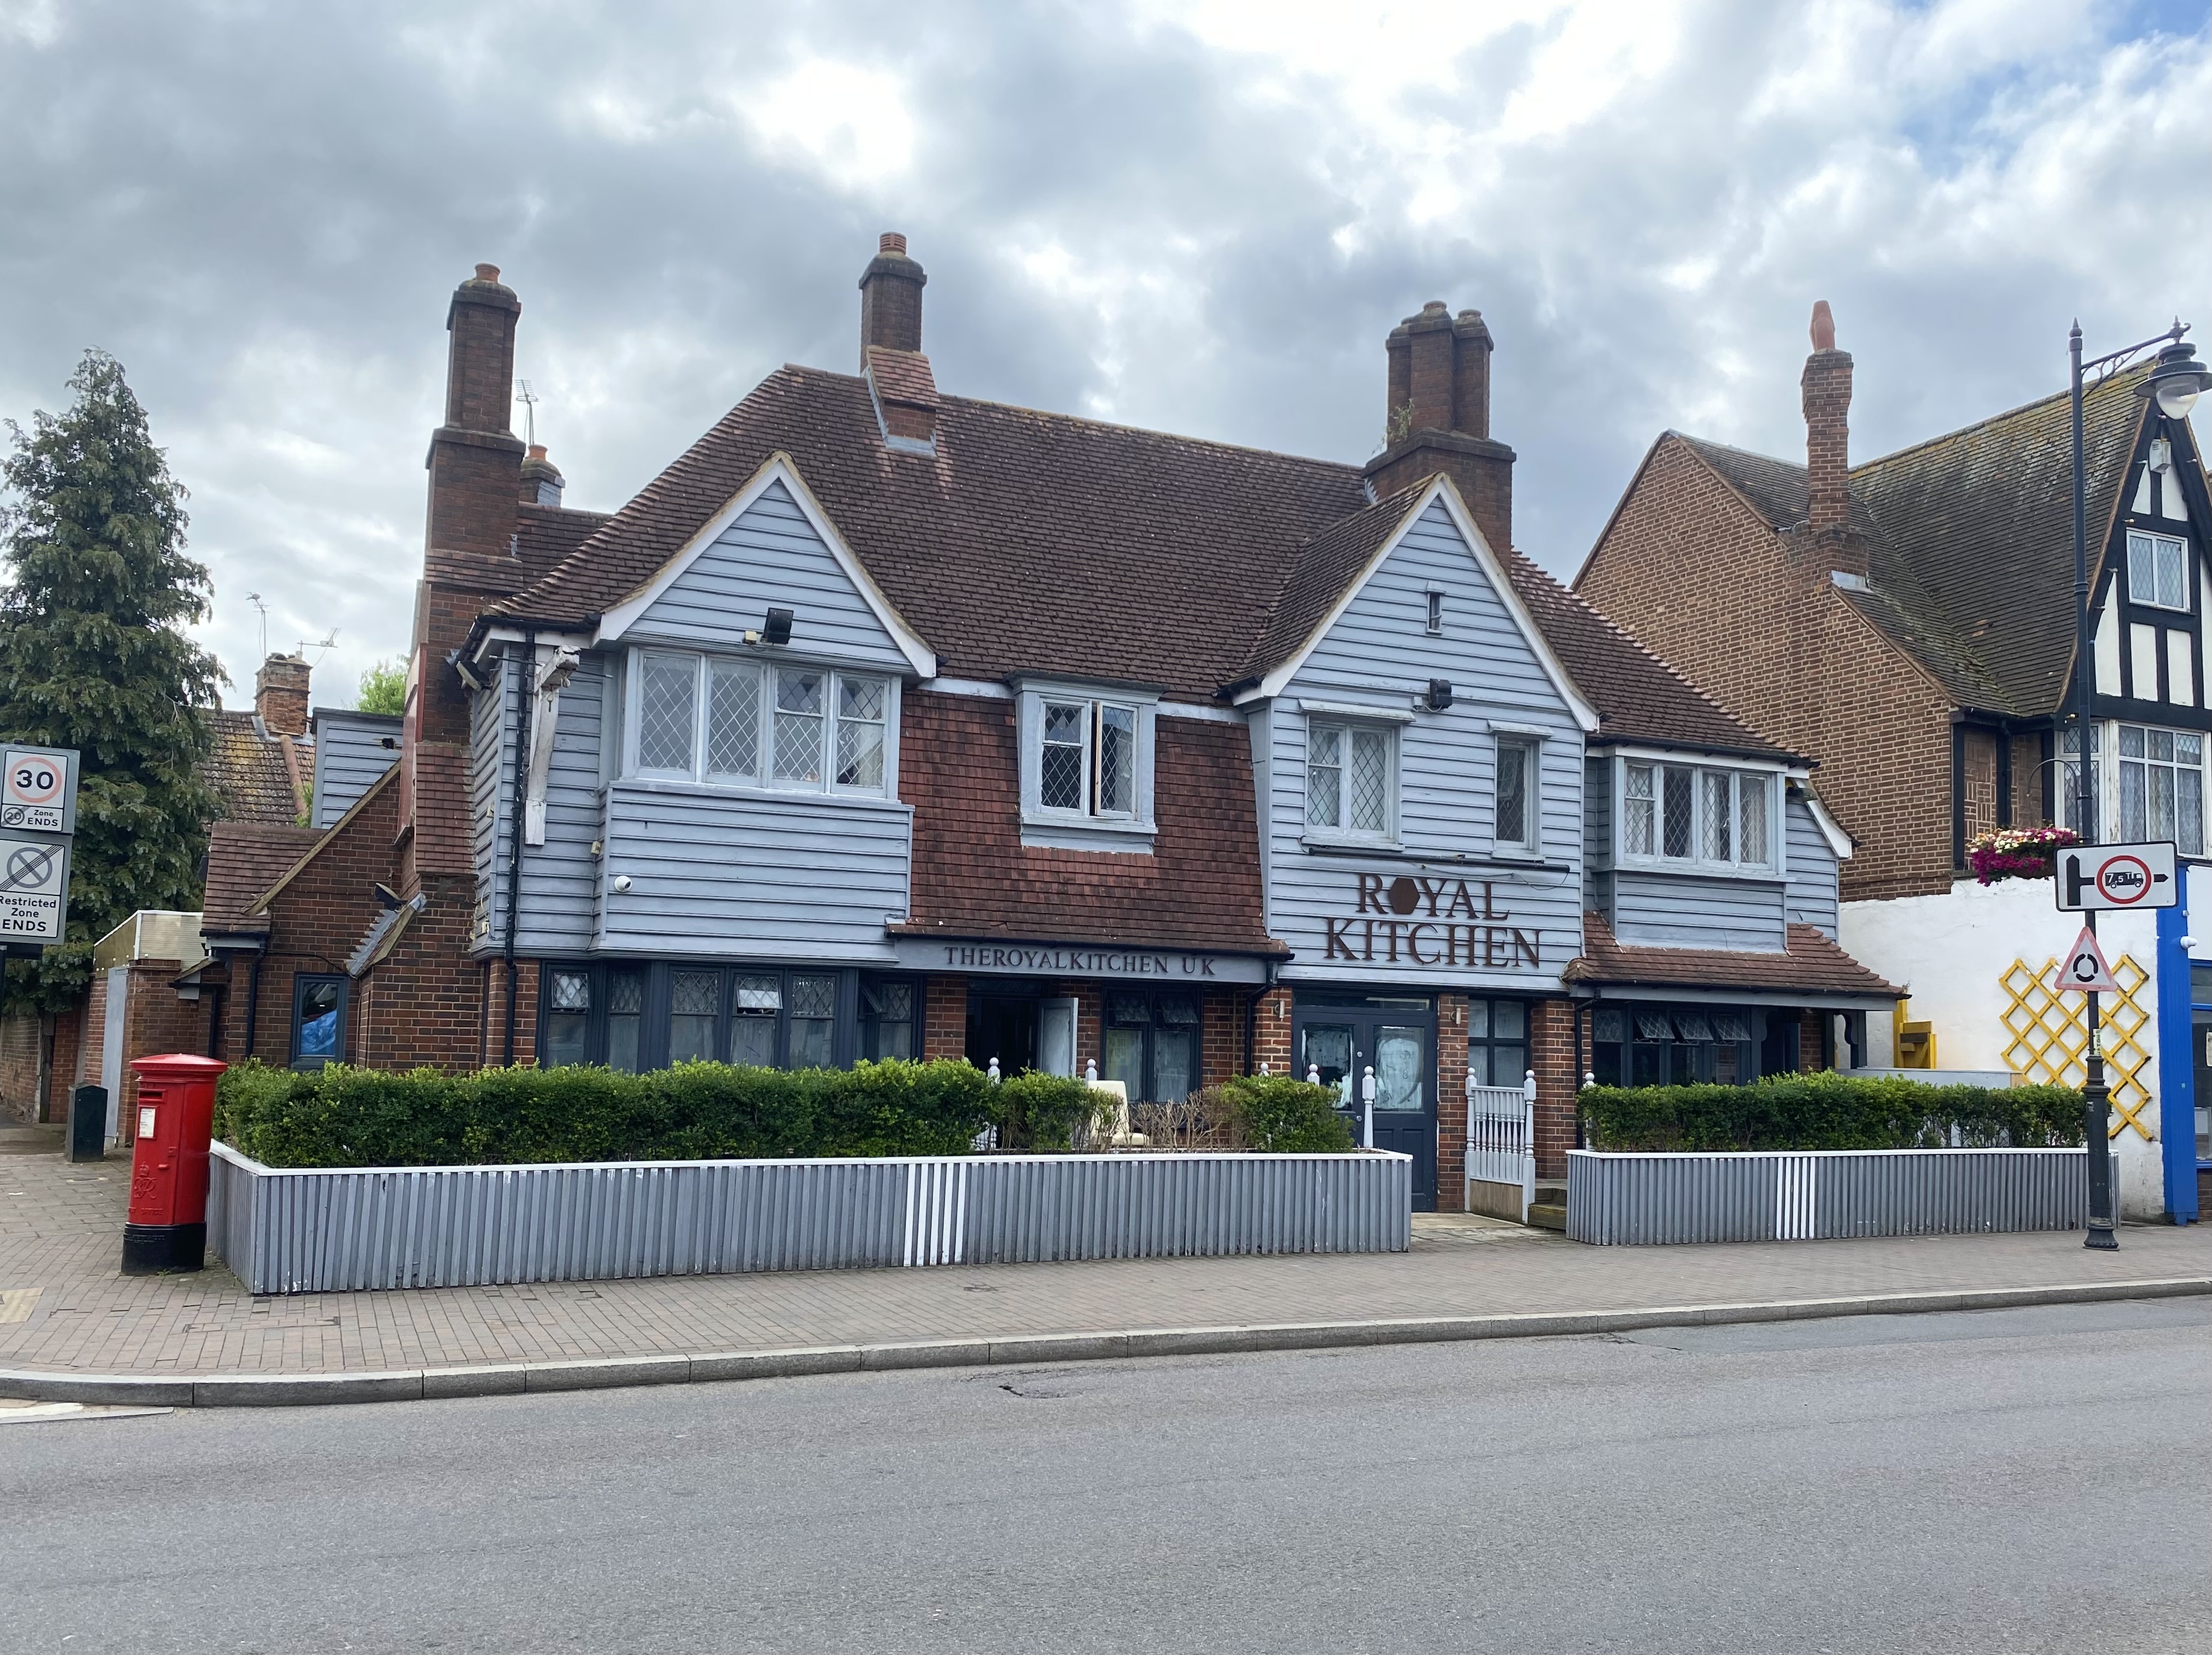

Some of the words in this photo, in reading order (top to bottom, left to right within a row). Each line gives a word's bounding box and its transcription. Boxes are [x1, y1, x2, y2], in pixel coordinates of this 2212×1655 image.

[16, 769, 54, 790] 30
[7, 812, 22, 821] 20
[27, 817, 59, 827] ENDS
[0, 895, 57, 908] Restricted
[11, 907, 39, 918] Zone
[2, 918, 47, 932] ENDS
[1323, 916, 1544, 970] KITCHEN
[944, 946, 1170, 974] THEROYALKITCHEN
[1181, 956, 1216, 976] UK
